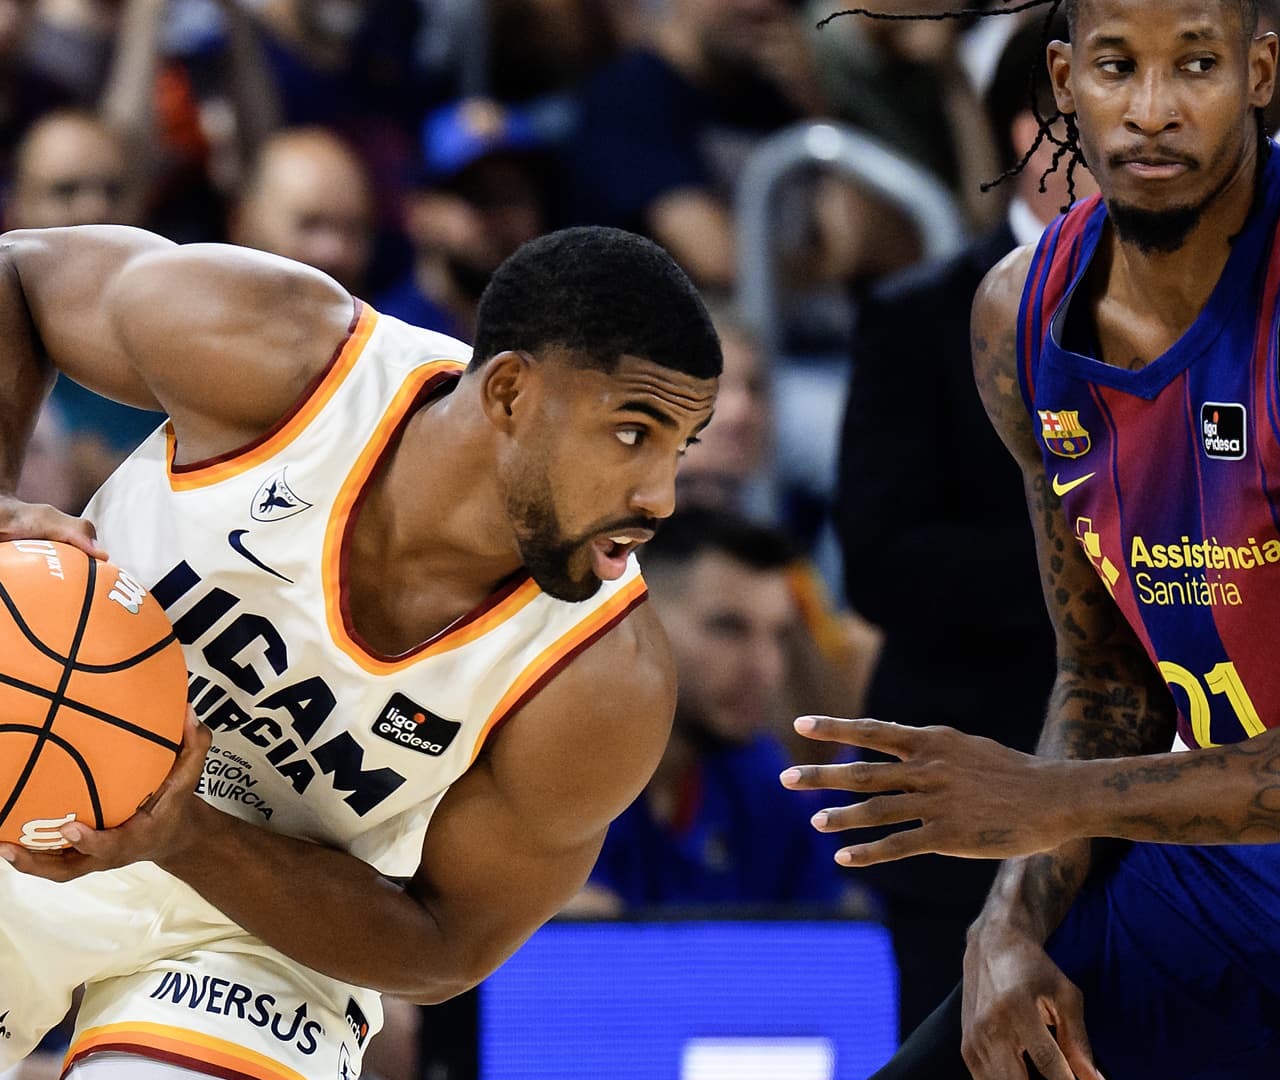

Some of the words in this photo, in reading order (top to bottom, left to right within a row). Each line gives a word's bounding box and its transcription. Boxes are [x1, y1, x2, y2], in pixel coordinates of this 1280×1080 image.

[1205, 436, 1240, 452] endesa
[1135, 573, 1243, 606] Sanitària
[149, 559, 408, 818] UCAM
[186, 670, 316, 796] URCIA
[386, 707, 418, 732] liga
[379, 722, 443, 753] endesa
[205, 757, 259, 788] GIÓN
[207, 777, 274, 821] MURCIA
[149, 971, 324, 1056] INVERSUS
